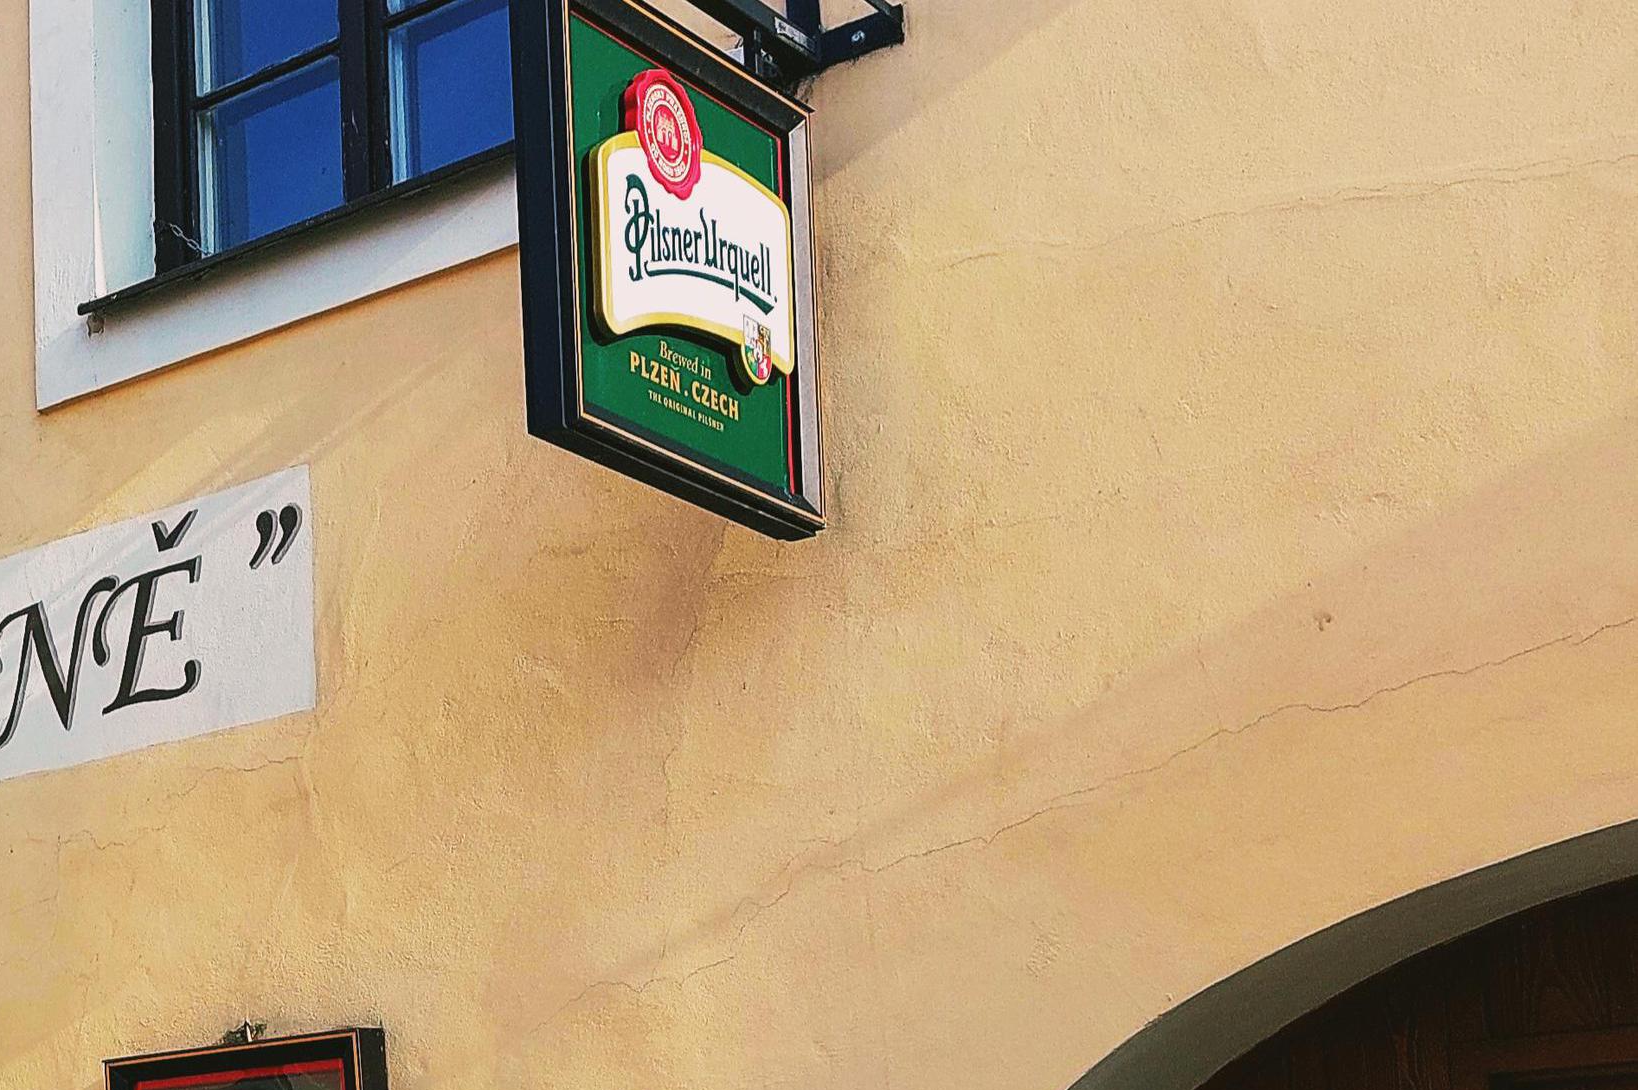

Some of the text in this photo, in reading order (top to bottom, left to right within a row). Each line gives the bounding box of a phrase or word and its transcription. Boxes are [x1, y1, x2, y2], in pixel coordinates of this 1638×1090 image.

[624, 173, 772, 302] Pilsner Urquell
[629, 350, 739, 423] PLZEŇ CZECH
[657, 339, 712, 381] Brewed in
[646, 389, 725, 433] THE ORIGINAL PILSNER
